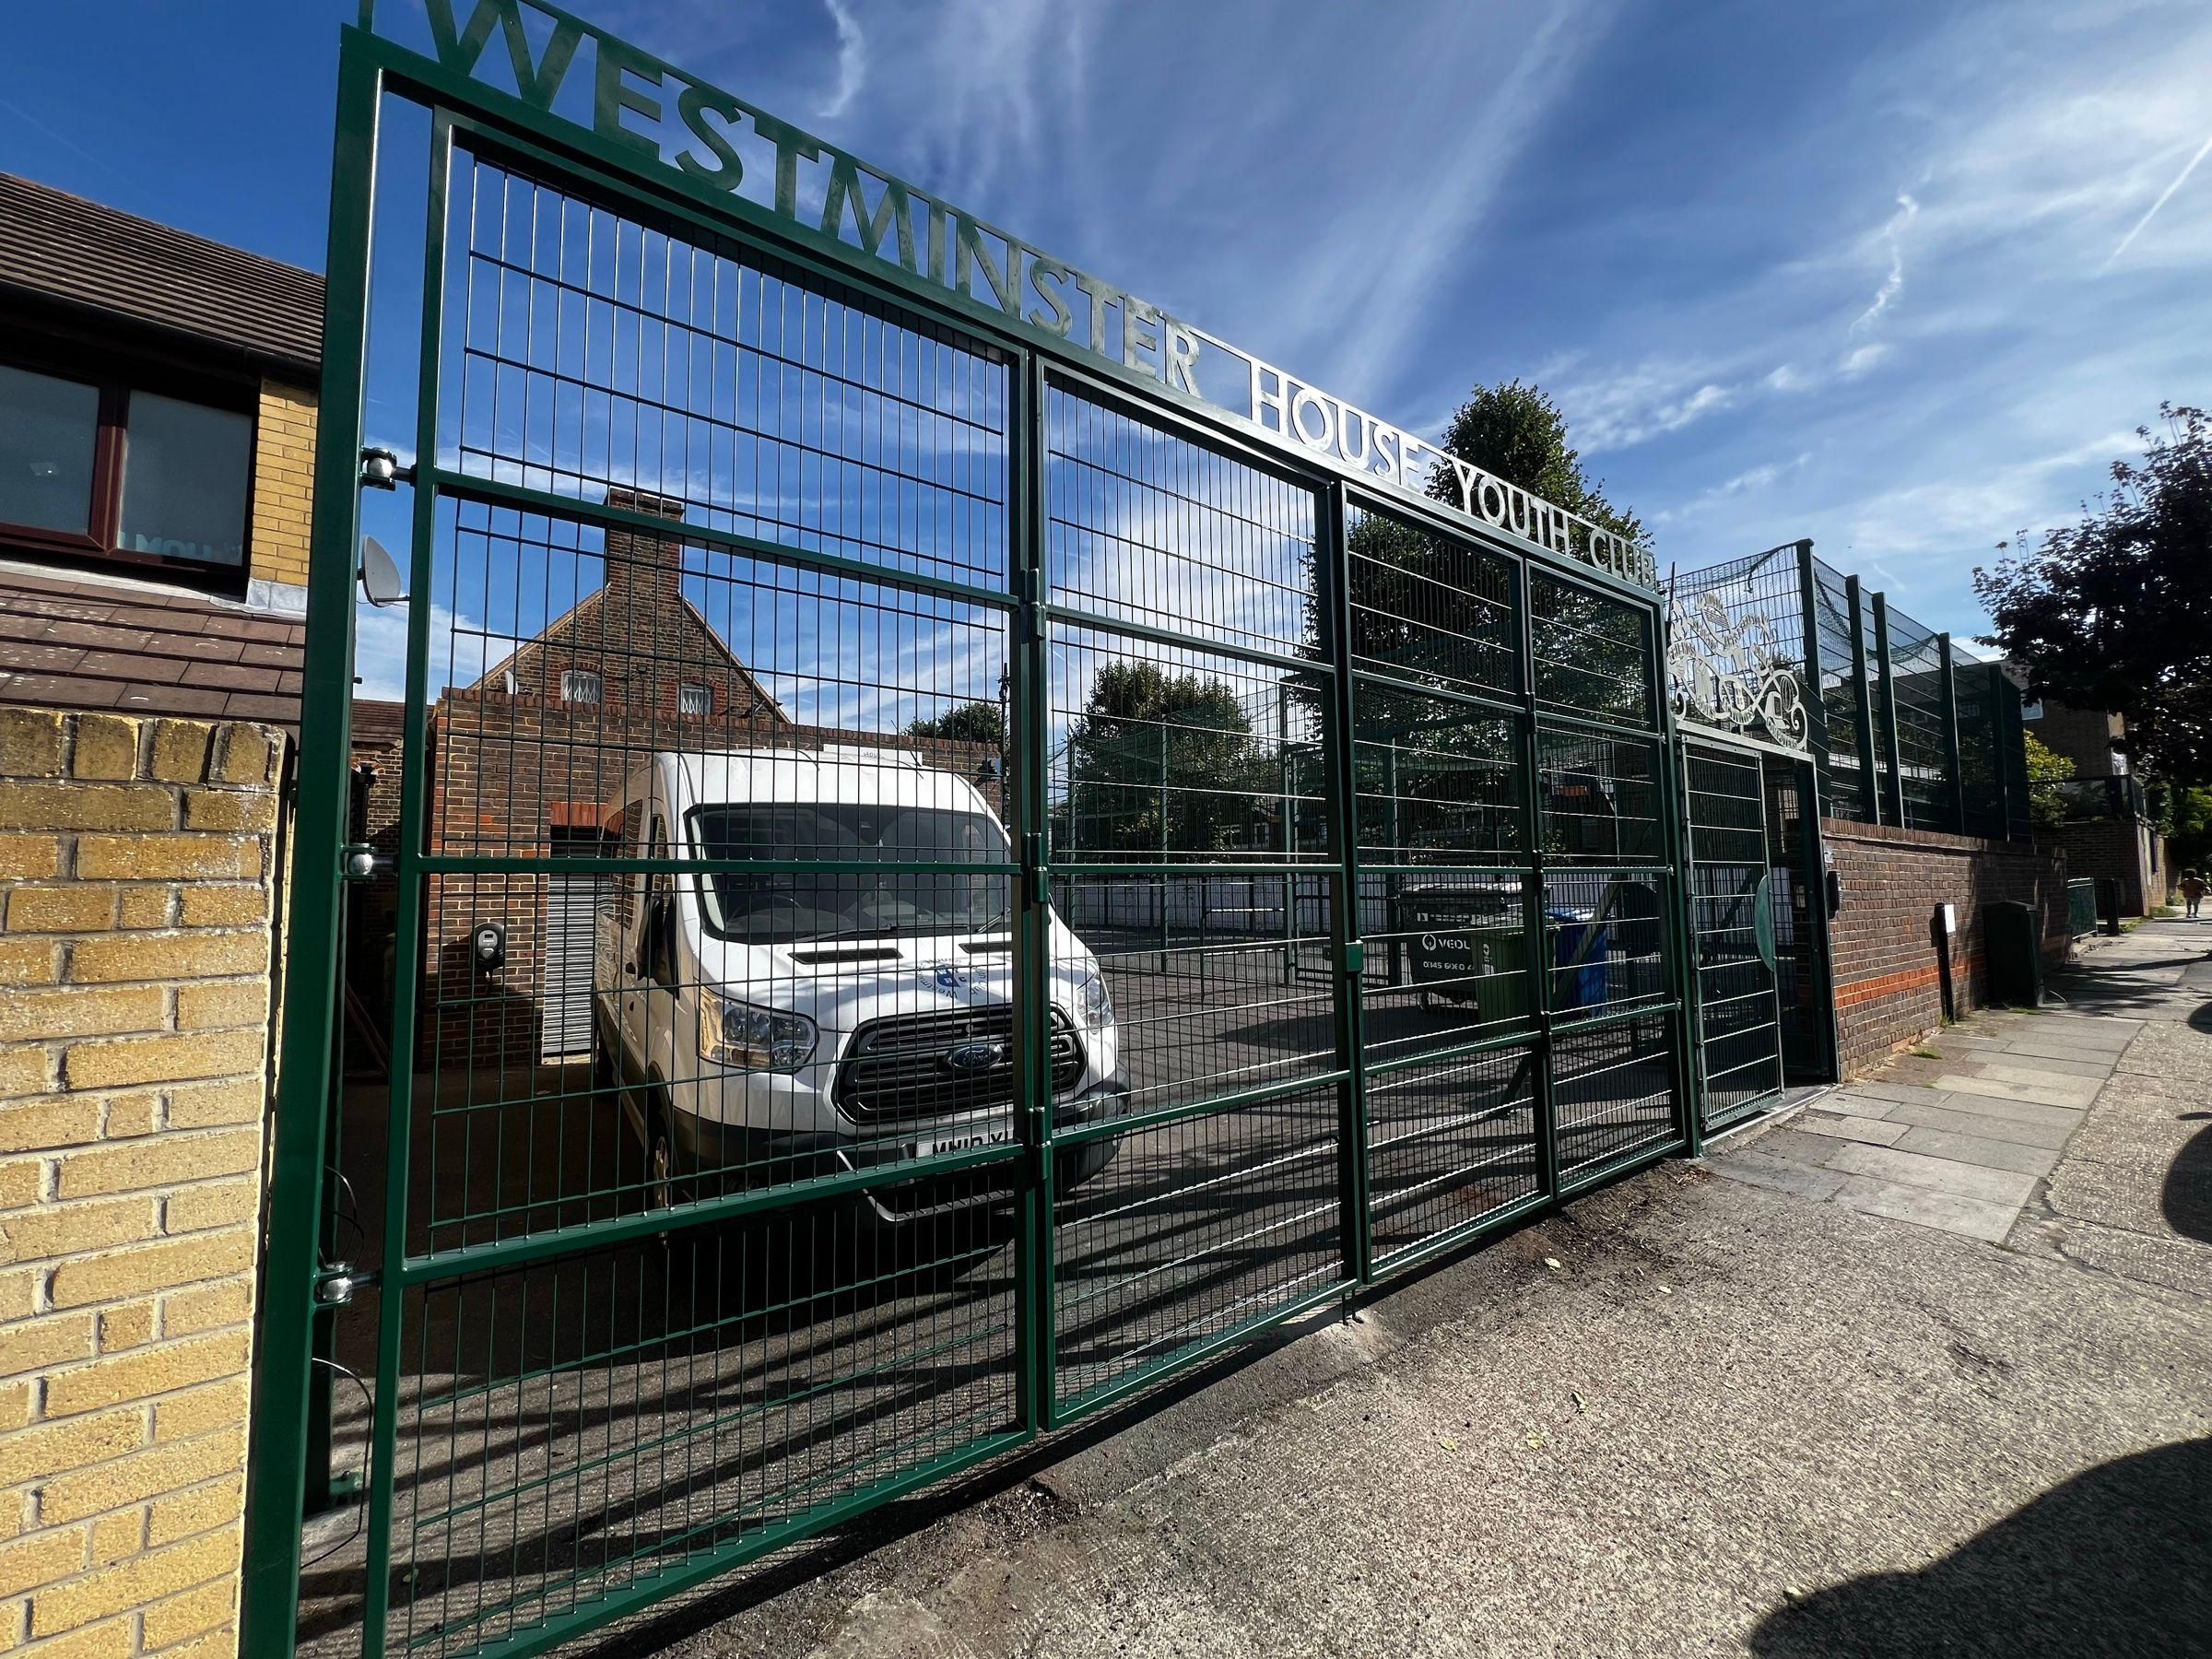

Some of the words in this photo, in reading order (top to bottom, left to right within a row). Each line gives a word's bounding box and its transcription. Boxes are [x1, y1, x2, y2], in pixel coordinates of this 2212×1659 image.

[422, 0, 1202, 398] WESTMINSTER
[1251, 356, 1420, 493] HOUSE
[1451, 455, 1571, 557] YOUTH
[1589, 525, 1655, 592] CLUB
[1438, 938, 1471, 950] VEOL
